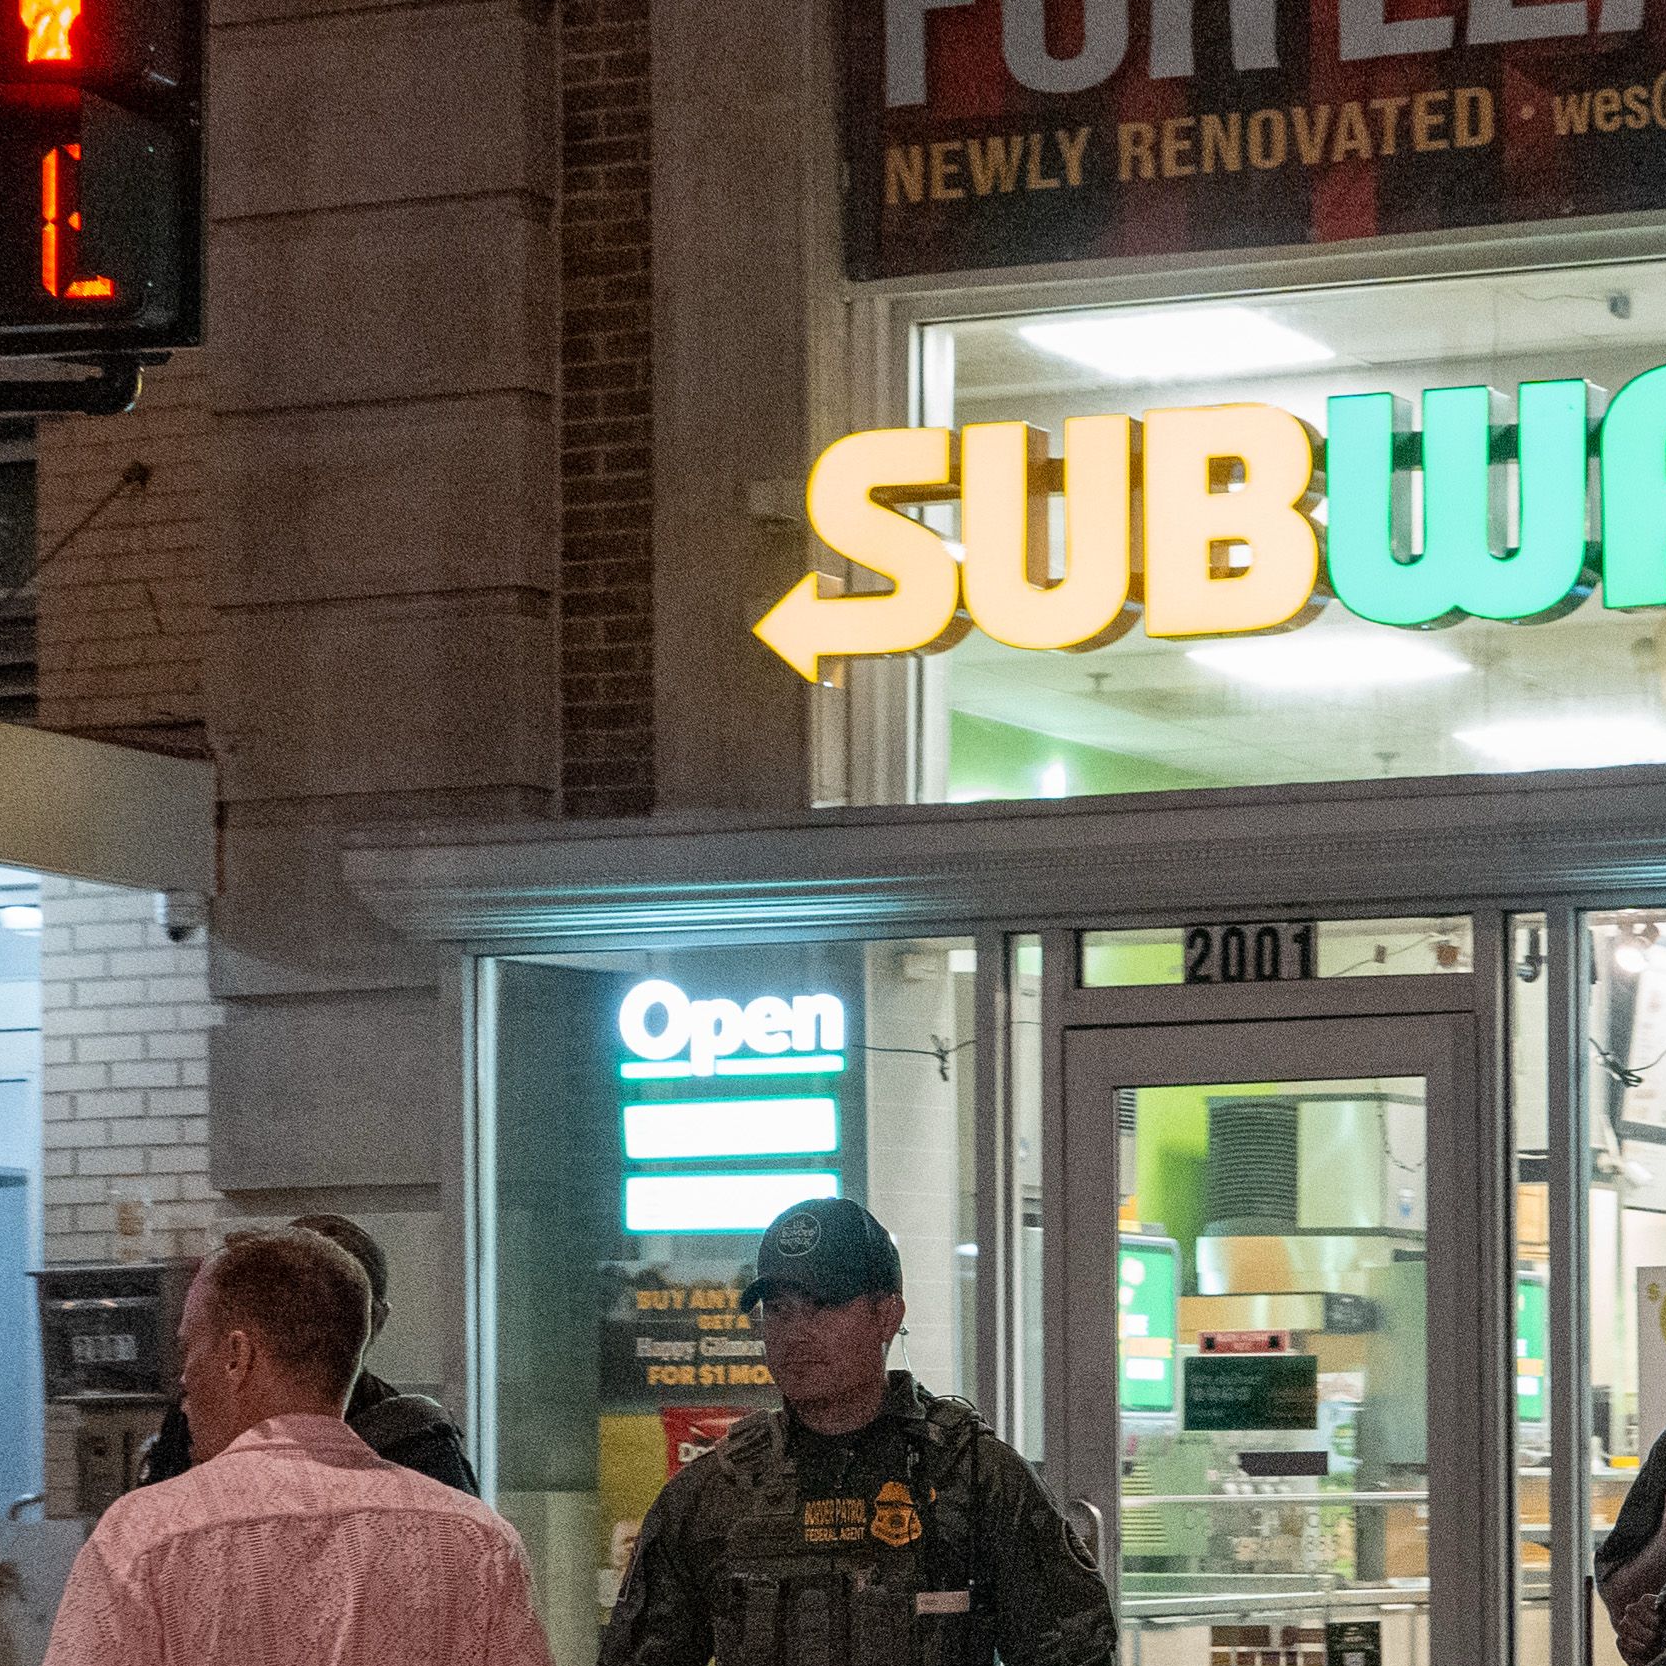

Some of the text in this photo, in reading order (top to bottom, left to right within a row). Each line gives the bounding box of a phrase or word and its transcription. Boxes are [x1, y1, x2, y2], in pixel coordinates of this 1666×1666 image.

[884, 126, 1093, 205] NEWLY
[1117, 86, 1495, 182] RENOVATED
[1186, 927, 1315, 983] 2001
[619, 979, 845, 1076] Open
[636, 1289, 685, 1311] BUY
[647, 1365, 696, 1386] FOR
